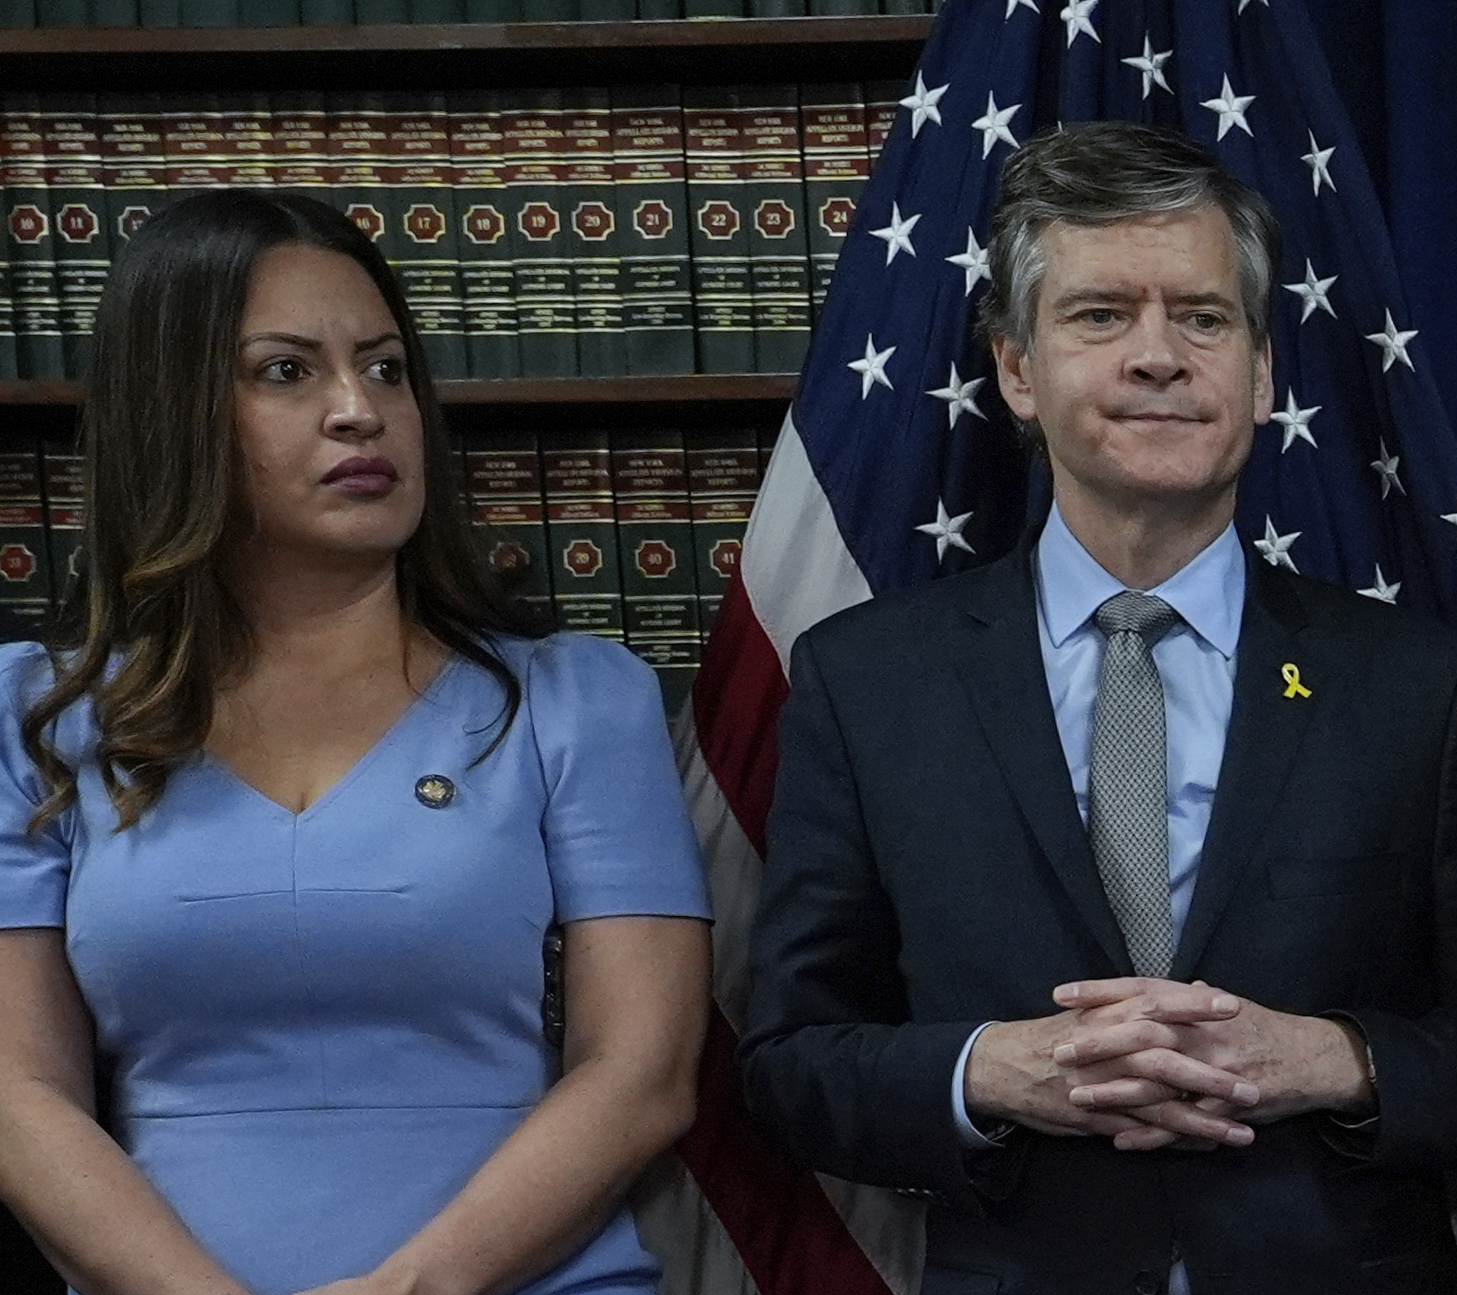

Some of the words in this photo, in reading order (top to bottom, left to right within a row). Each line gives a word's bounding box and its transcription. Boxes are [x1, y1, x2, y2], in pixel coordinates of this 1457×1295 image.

[531, 215, 546, 228] 19
[645, 214, 660, 226] 21
[711, 214, 727, 226] 22
[766, 213, 781, 225] 23
[833, 211, 848, 223] 24
[418, 217, 431, 230] 17
[721, 552, 735, 564] 41
